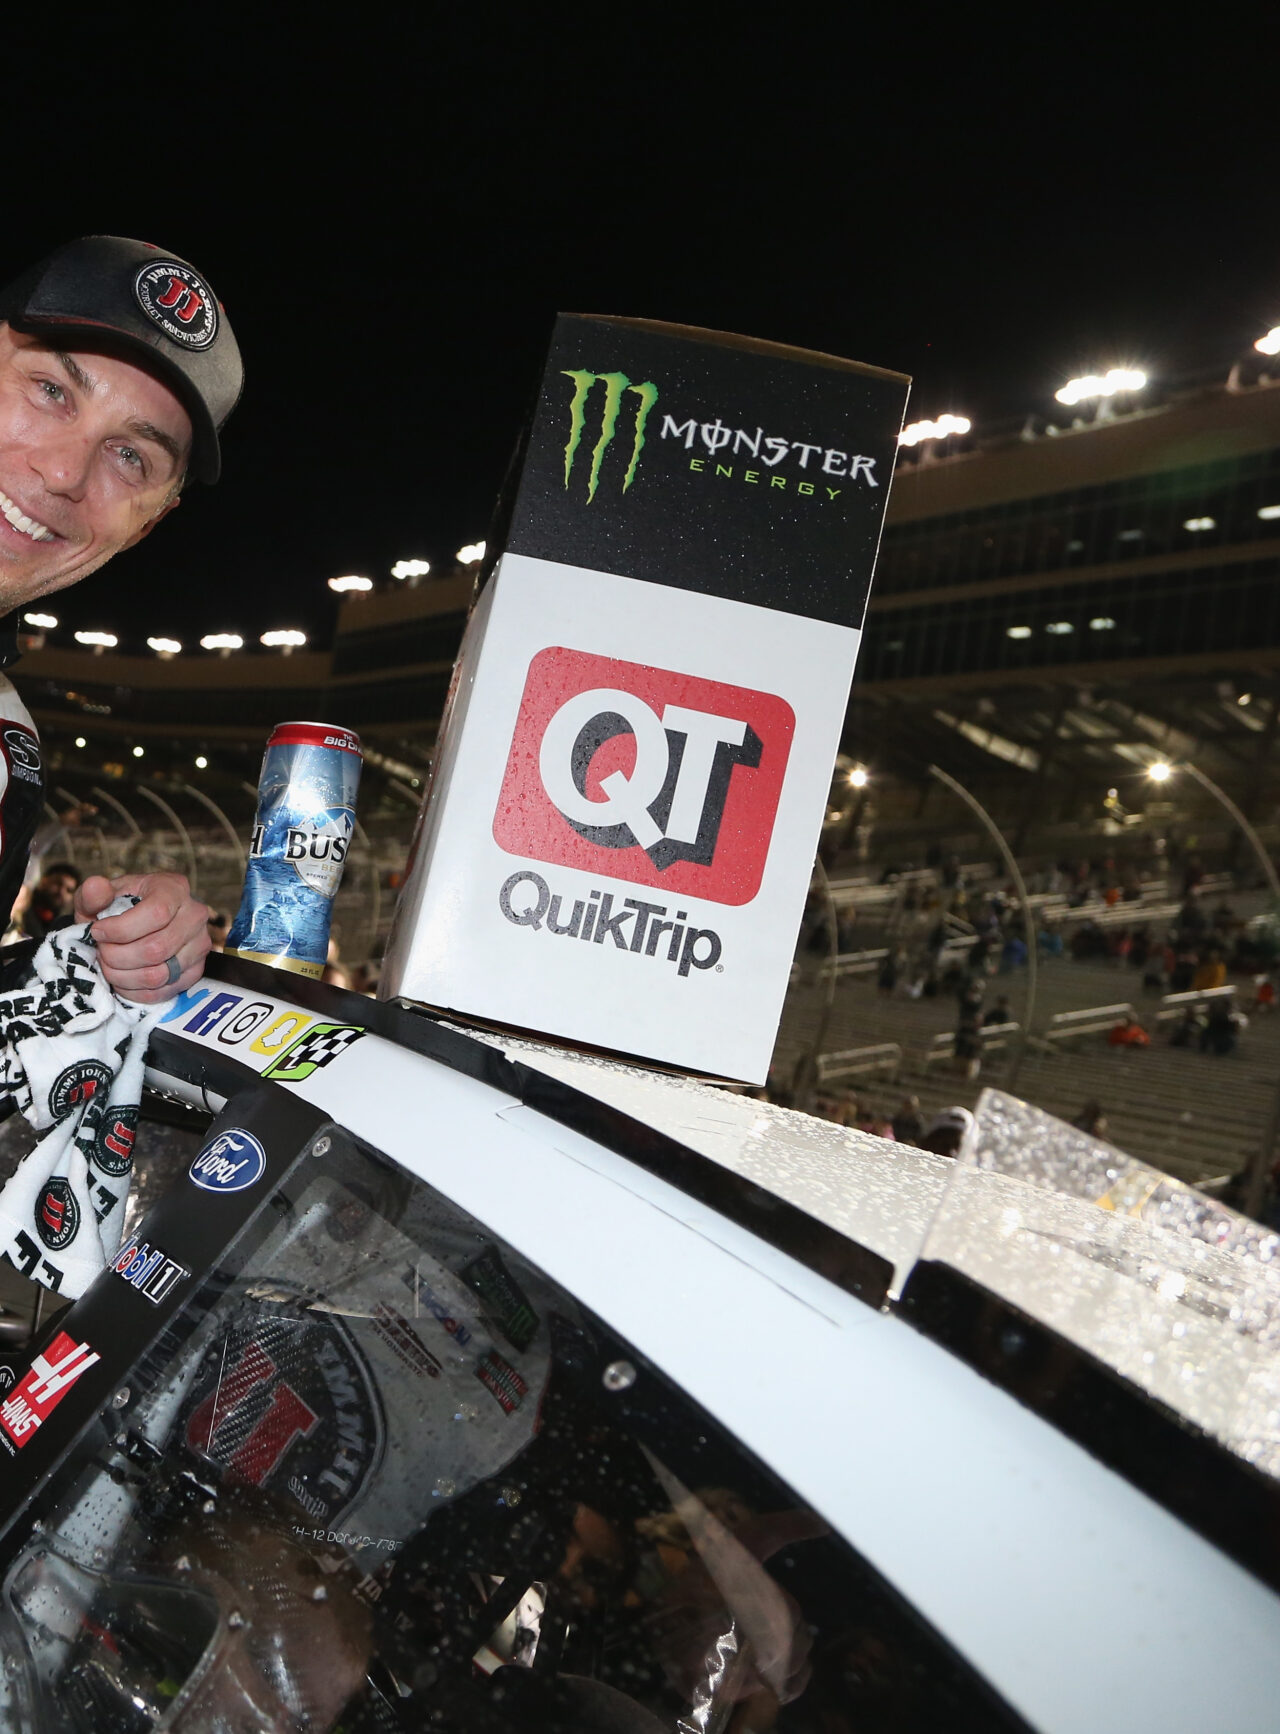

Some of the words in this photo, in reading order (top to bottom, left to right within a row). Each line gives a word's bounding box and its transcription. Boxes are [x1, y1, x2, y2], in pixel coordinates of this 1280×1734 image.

[147, 267, 191, 284] JIMMY
[192, 280, 213, 333] JOHN'S
[660, 414, 879, 488] MONSTER
[689, 458, 842, 500] ENERGY
[323, 736, 347, 748] BIG
[539, 687, 750, 852] QT
[285, 829, 350, 864] BUS
[498, 870, 723, 978] QuikTrip
[57, 1074, 78, 1107] JIMMY
[194, 1135, 249, 1184] Ford
[1, 1395, 42, 1437] HAAS
